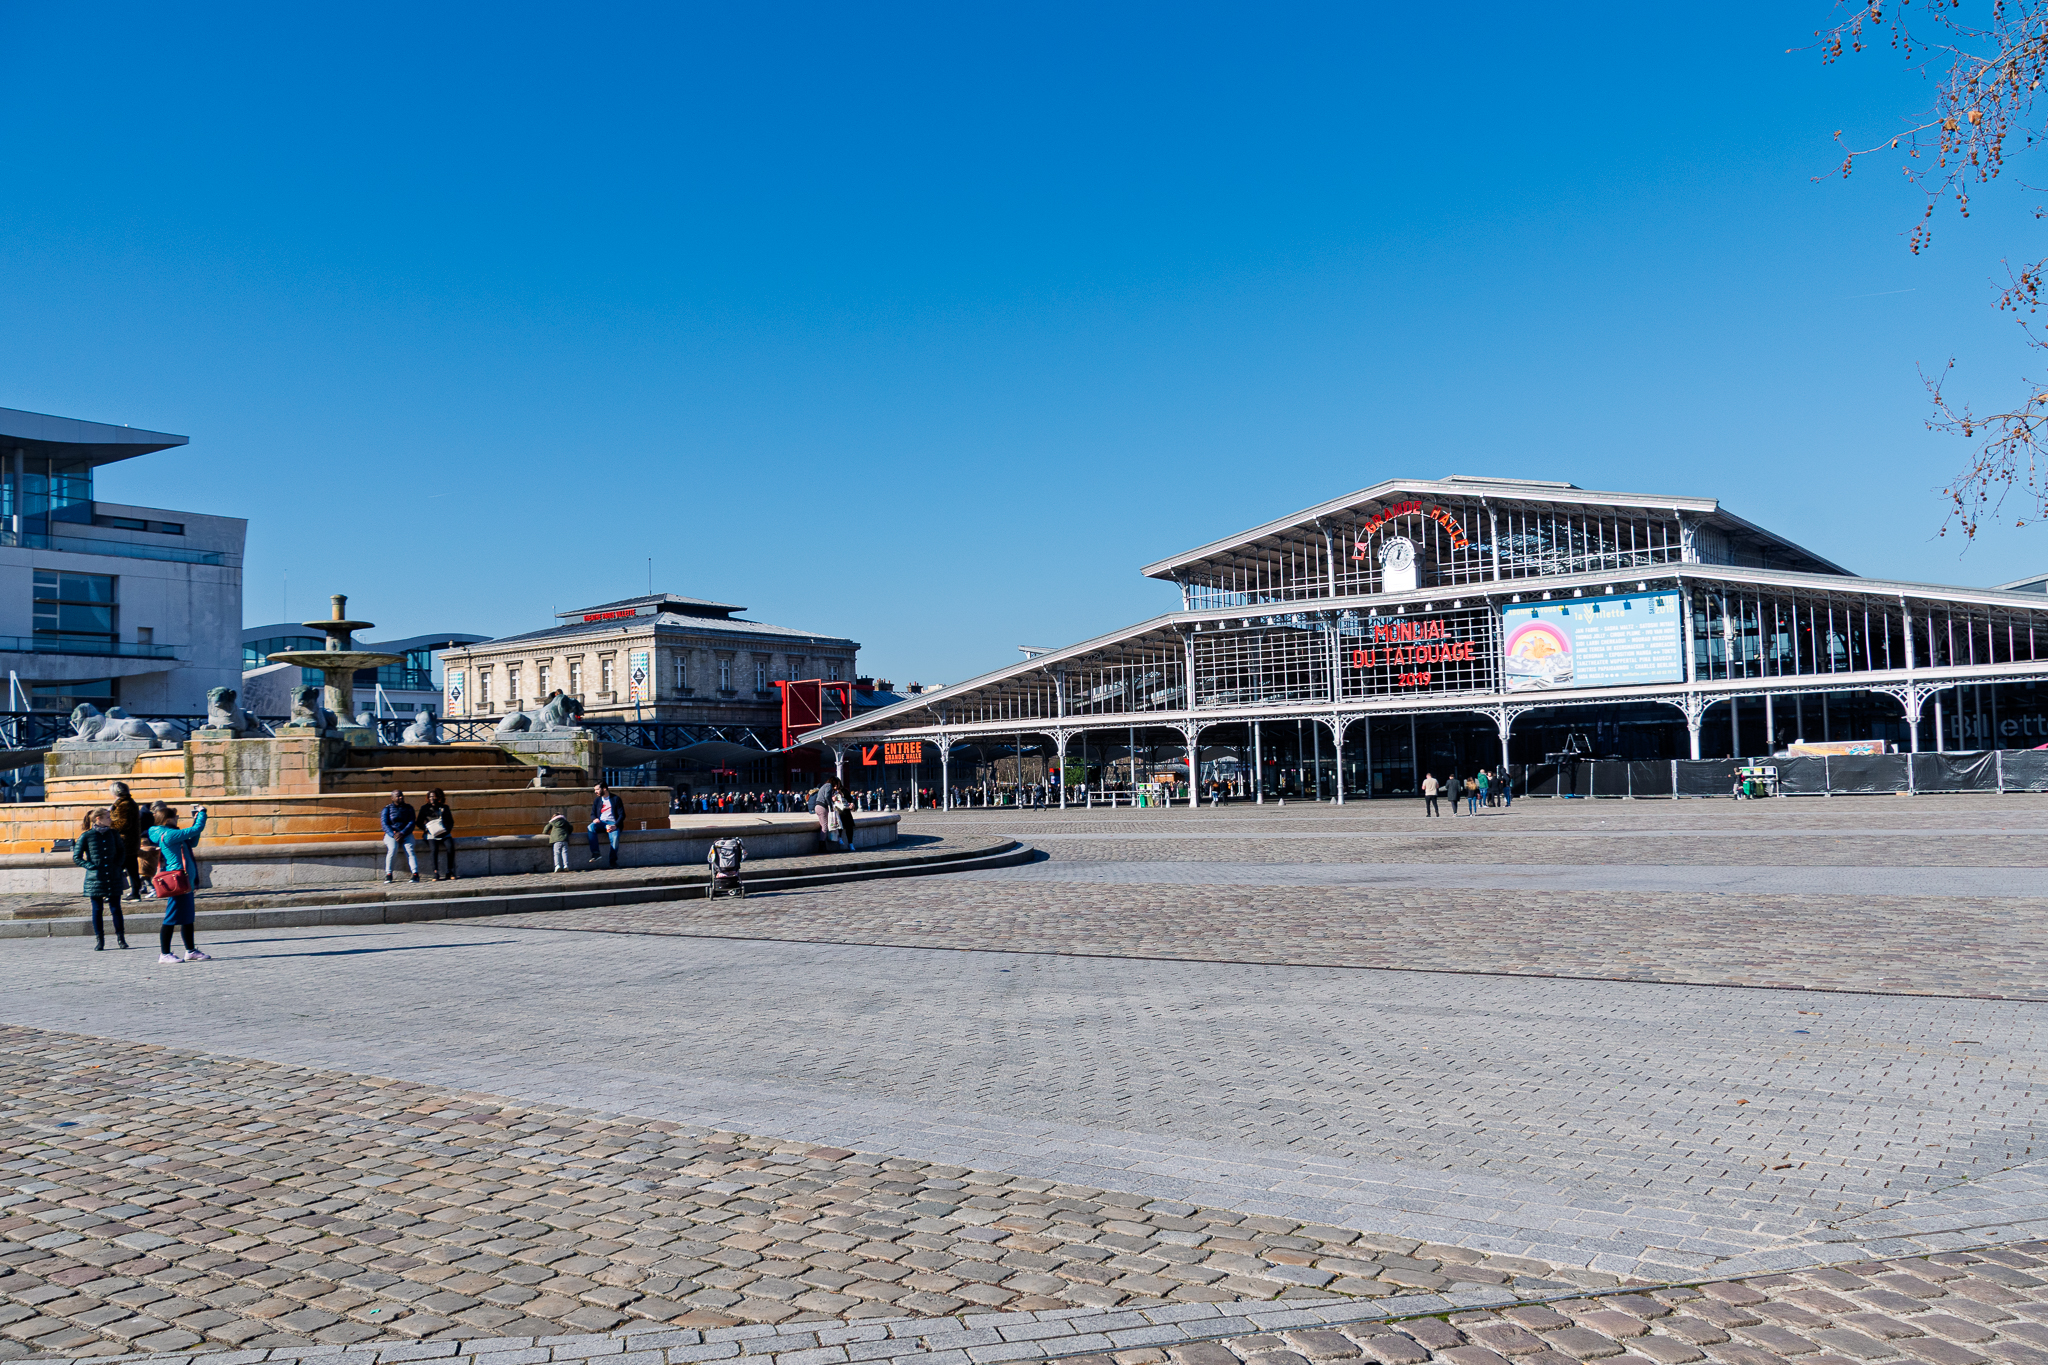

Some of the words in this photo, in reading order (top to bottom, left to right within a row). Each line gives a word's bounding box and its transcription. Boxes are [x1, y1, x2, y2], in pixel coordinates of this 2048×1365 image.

[1352, 542, 1367, 560] LA
[1365, 501, 1422, 534] GRANDE
[1430, 505, 1469, 549] HALLE
[1655, 604, 1674, 614] 2019
[1375, 619, 1451, 643] MONDIAL
[1353, 649, 1375, 668] DU
[1382, 641, 1476, 666] TATOUAGE
[1398, 671, 1431, 687] 2019
[1951, 713, 2048, 738] Bilett
[884, 742, 921, 754] ENTREE
